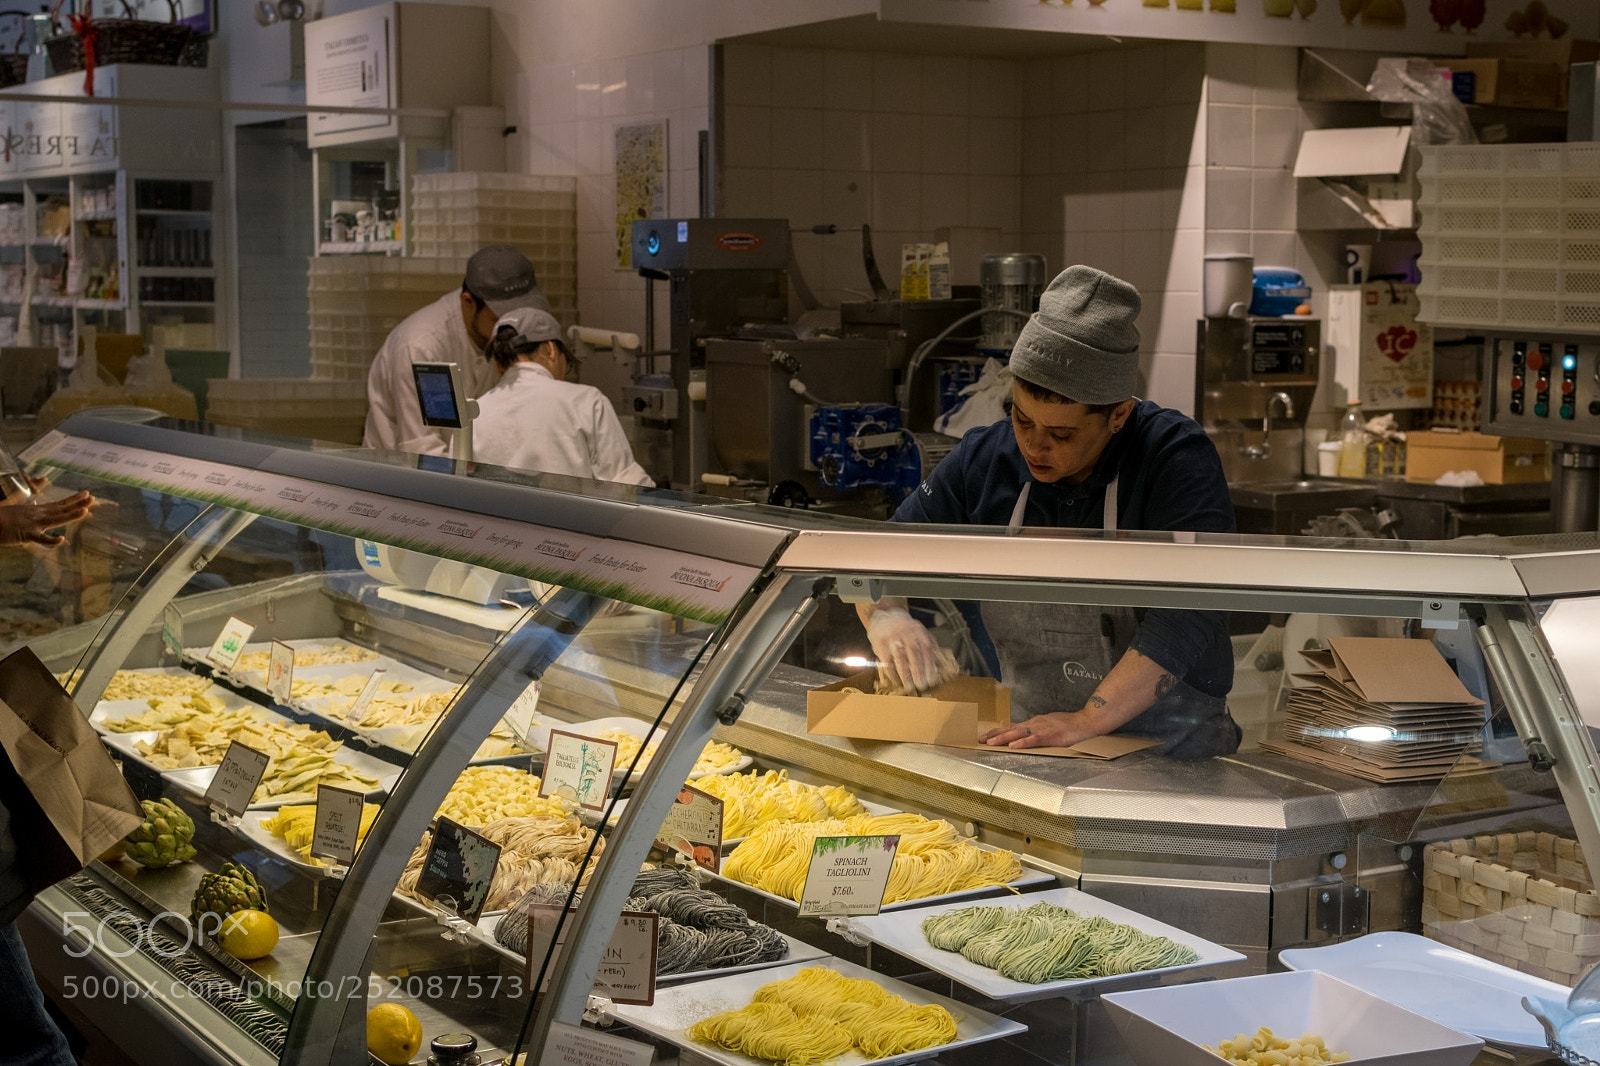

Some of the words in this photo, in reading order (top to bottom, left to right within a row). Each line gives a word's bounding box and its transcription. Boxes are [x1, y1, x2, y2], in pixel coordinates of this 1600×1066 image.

[1067, 668, 1103, 681] EATALY
[833, 857, 868, 867] SPINACH
[826, 867, 871, 877] TAGLIOLINI
